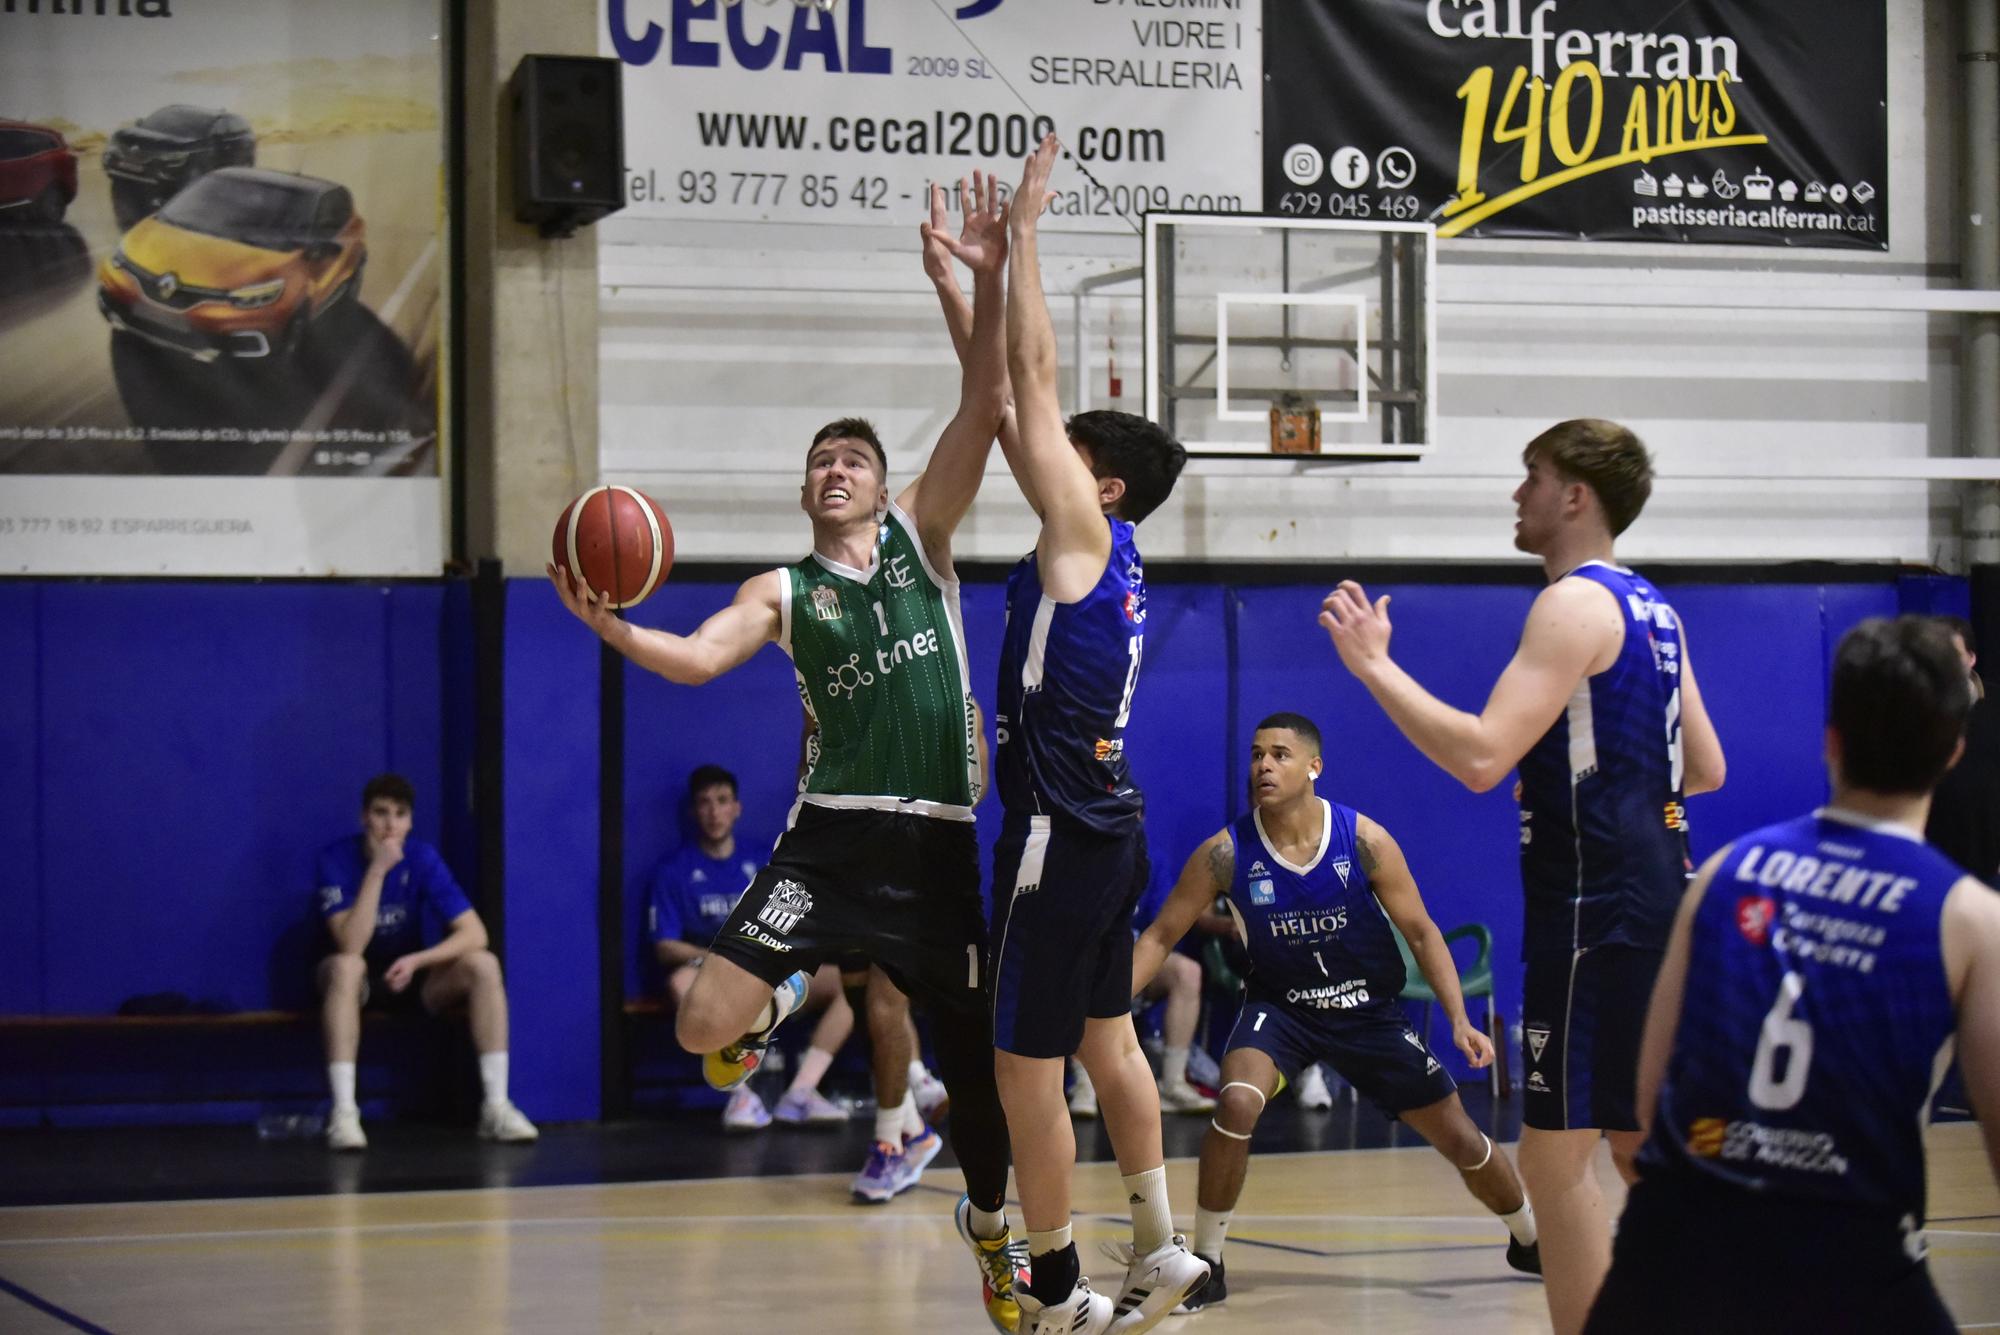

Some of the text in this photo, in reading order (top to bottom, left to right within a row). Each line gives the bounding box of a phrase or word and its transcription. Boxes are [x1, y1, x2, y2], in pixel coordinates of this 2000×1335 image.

[607, 0, 893, 74] CECAL
[1132, 19, 1242, 49] VIDRE I
[1427, 0, 1526, 38] cal
[1527, 0, 1743, 90] ferran
[907, 56, 993, 80] 2009 SL
[1029, 55, 1242, 90] SERRALLERIA
[698, 110, 1166, 163] www.cecal2009.com
[1443, 61, 1604, 216] 140
[622, 167, 666, 203] el.
[678, 170, 718, 204] 93
[729, 172, 788, 205] 777
[800, 174, 839, 207] 85
[850, 177, 889, 210] 42
[1328, 193, 1371, 218] 045
[1378, 195, 1420, 220] 469
[1632, 203, 1877, 232] pastisseriacalferran.cat
[872, 600, 889, 637] 1
[1735, 845, 1919, 913] LORENTE
[738, 920, 793, 953] 70 anys
[1269, 911, 1348, 938] HELIOS
[966, 943, 979, 989] 1
[1312, 951, 1329, 978] 1
[1253, 1011, 1267, 1032] 1
[1748, 971, 1815, 1111] 6
